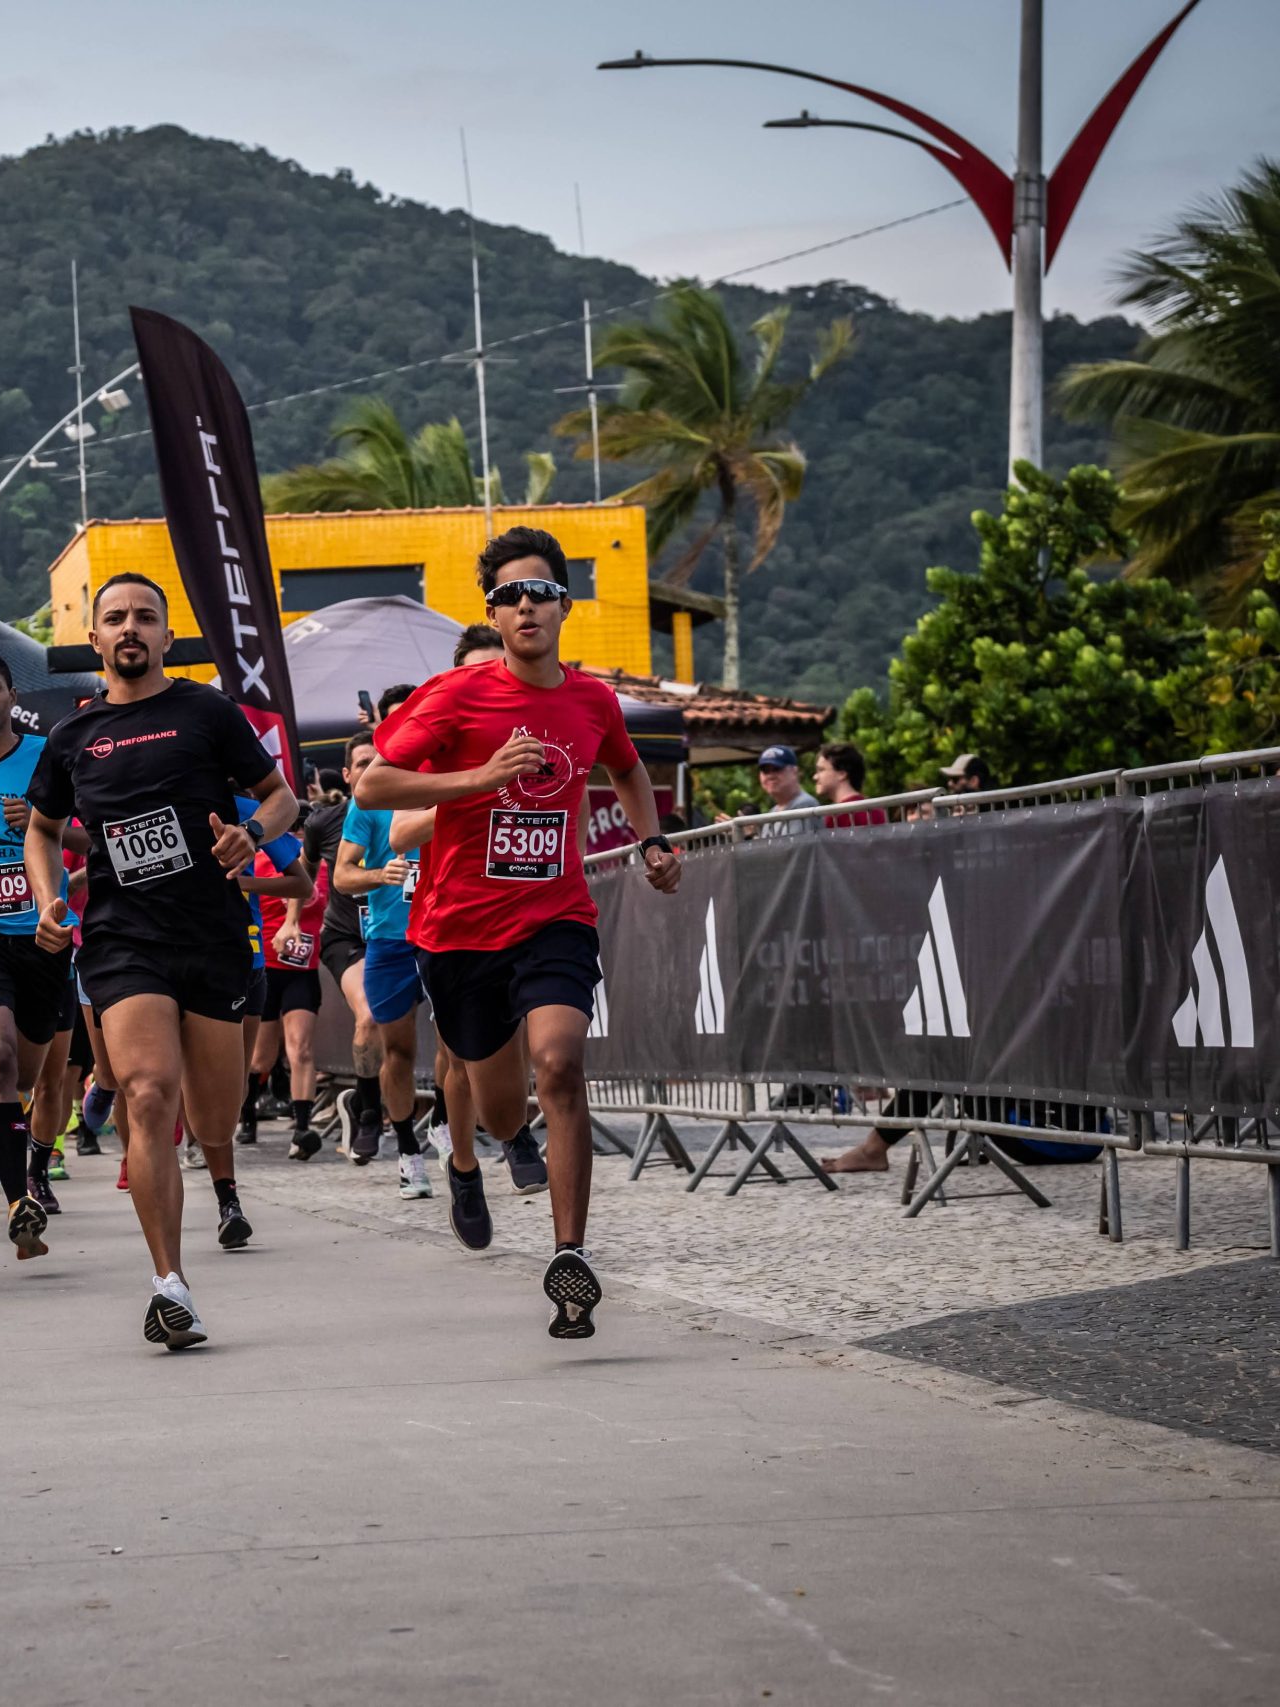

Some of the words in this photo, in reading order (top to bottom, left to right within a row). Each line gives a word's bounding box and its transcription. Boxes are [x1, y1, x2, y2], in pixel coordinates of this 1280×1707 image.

[199, 430, 271, 701] XTERRA
[116, 730, 178, 748] PERFORMANCE
[123, 815, 167, 833] XTERRA
[516, 817, 559, 825] XTERRA
[588, 800, 632, 845] FRO
[115, 825, 179, 862] 1066
[493, 828, 558, 856] 5309
